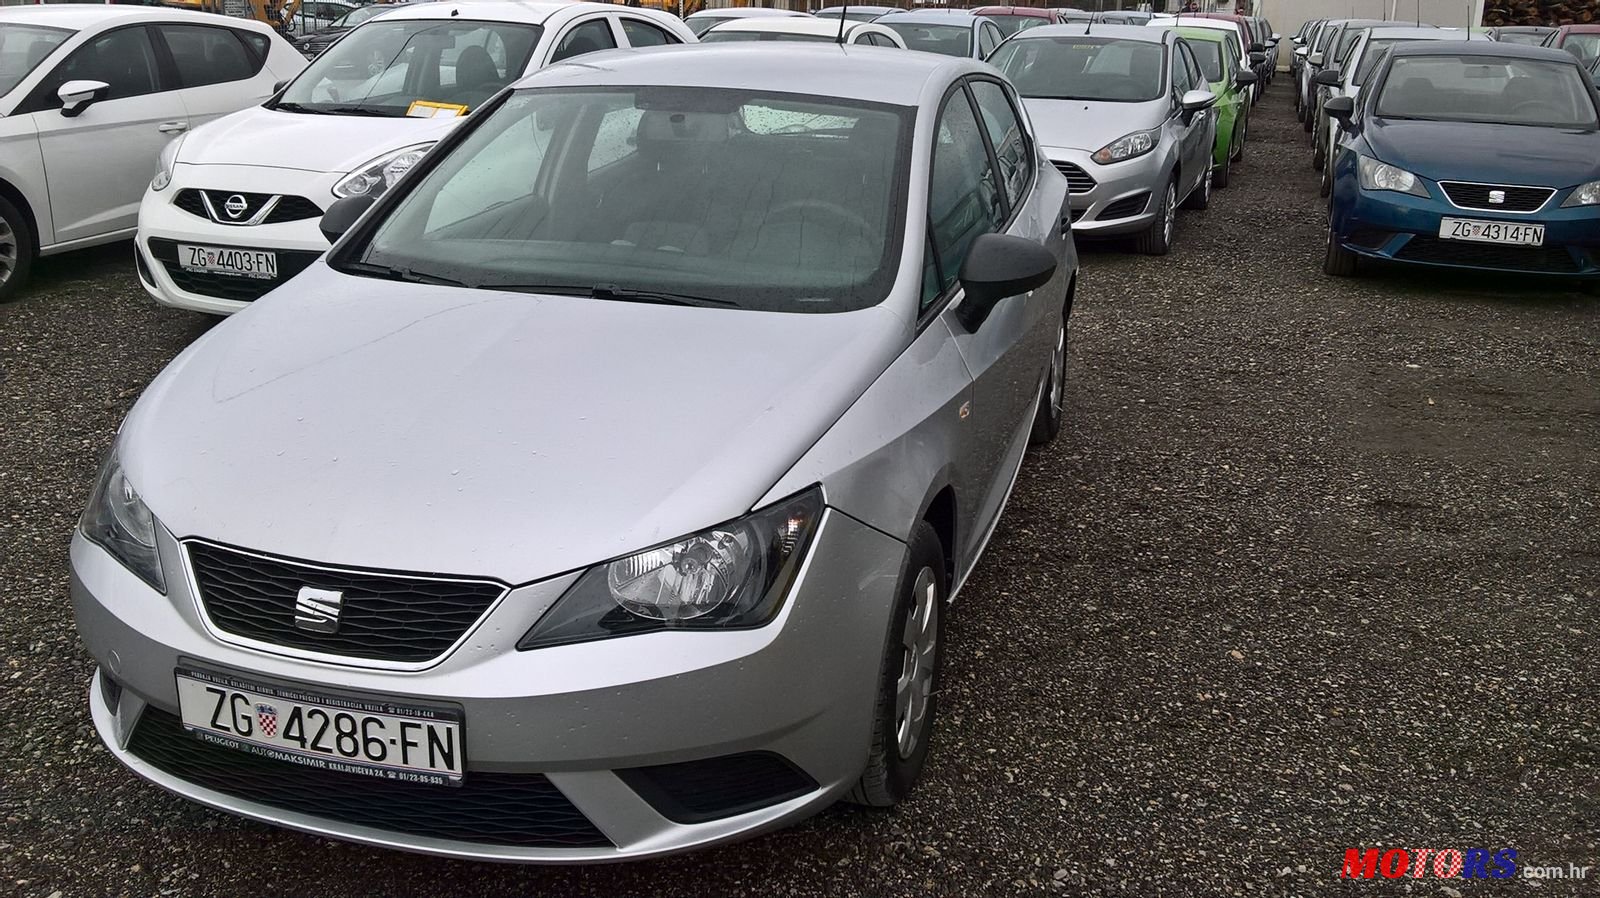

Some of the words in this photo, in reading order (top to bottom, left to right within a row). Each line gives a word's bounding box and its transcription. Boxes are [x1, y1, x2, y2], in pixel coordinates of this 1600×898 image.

[1452, 221, 1471, 237] ZG
[188, 247, 207, 266] ZG
[205, 686, 253, 737] ZG
[204, 734, 239, 749] PEUGEOT
